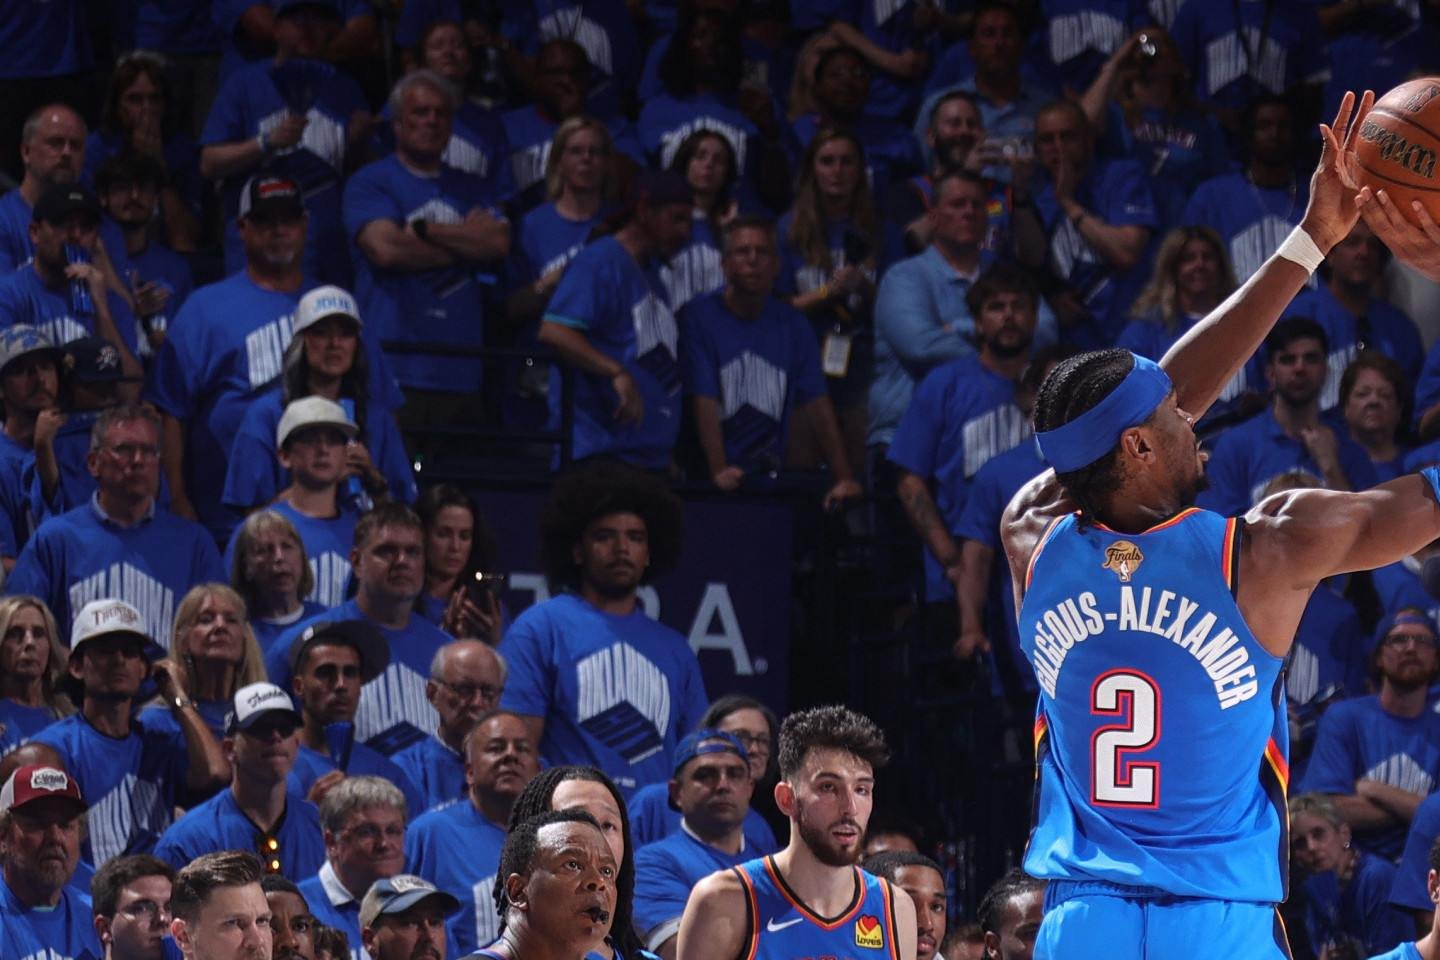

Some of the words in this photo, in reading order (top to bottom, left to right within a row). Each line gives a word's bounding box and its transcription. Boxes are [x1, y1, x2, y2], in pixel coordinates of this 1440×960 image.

[1102, 544, 1143, 567] Finals
[1034, 586, 1259, 710] GILGEOUS-ALEXANDER
[1090, 667, 1161, 809] 2
